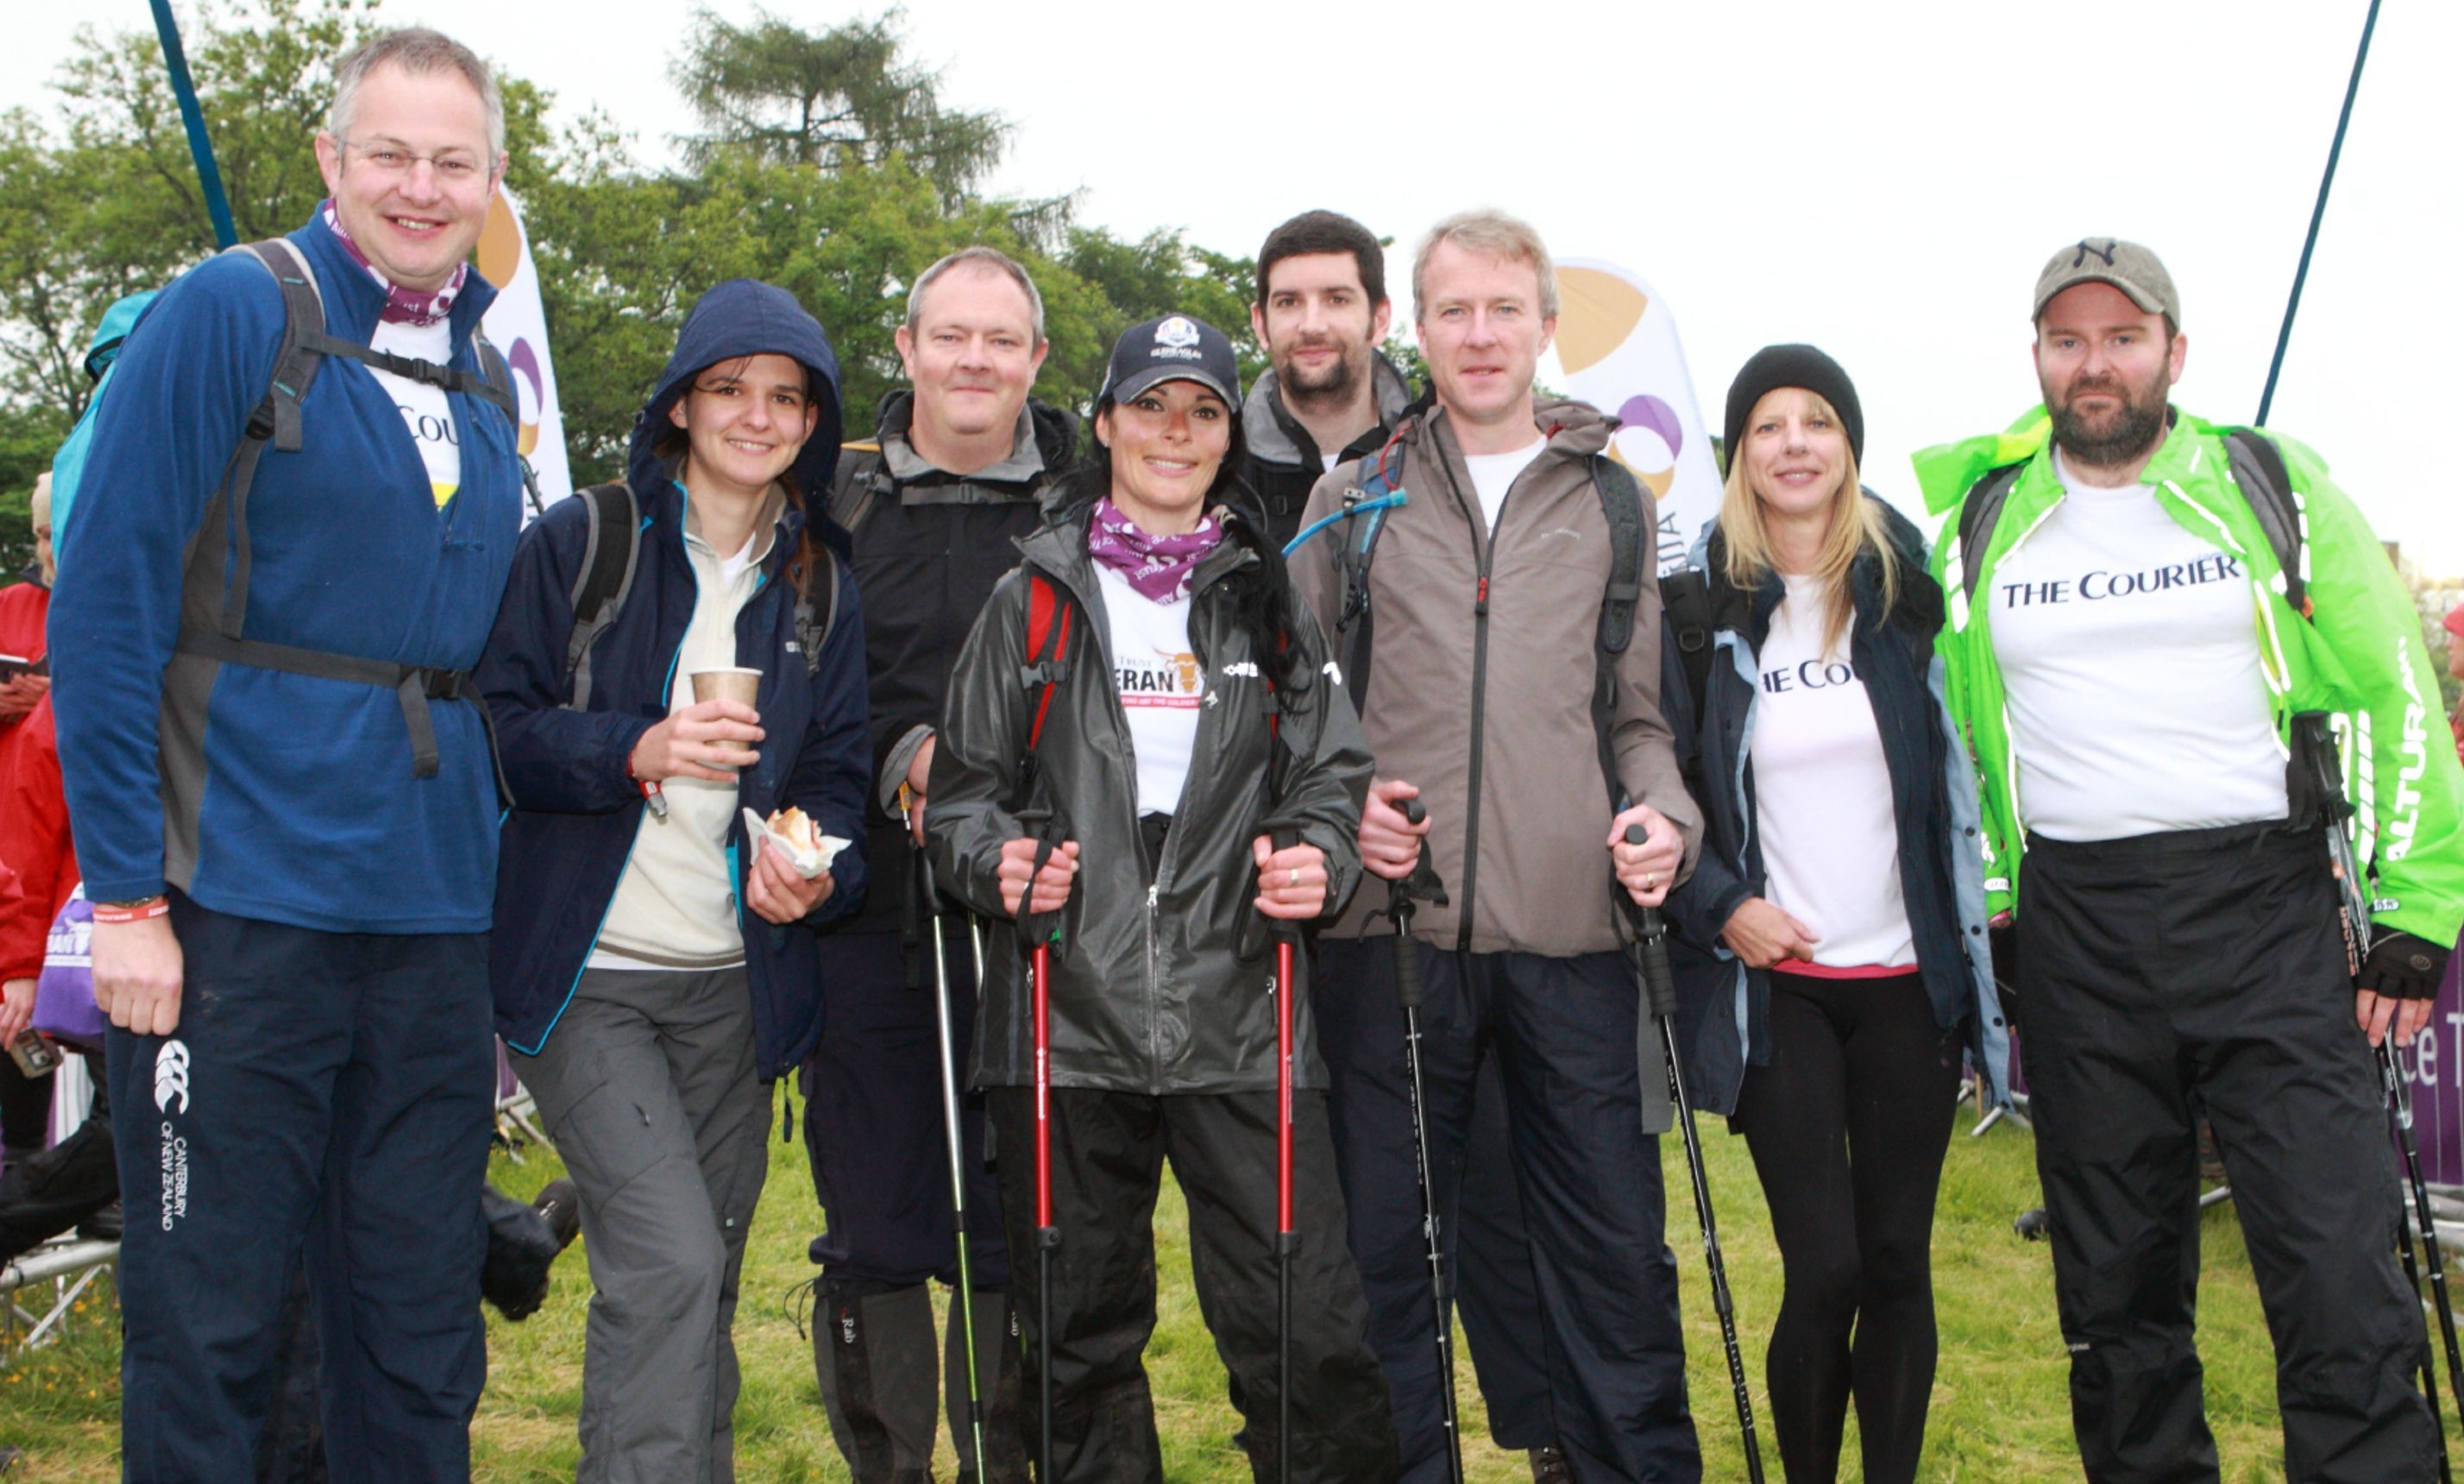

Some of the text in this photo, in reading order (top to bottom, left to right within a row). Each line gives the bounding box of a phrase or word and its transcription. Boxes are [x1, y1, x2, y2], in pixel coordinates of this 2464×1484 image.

[2002, 555, 2241, 609] THE COURIER
[161, 1121, 174, 1231] OF NEW ZEALAND
[173, 1136, 188, 1218] CANTERBURY
[841, 1317, 857, 1343] Rab
